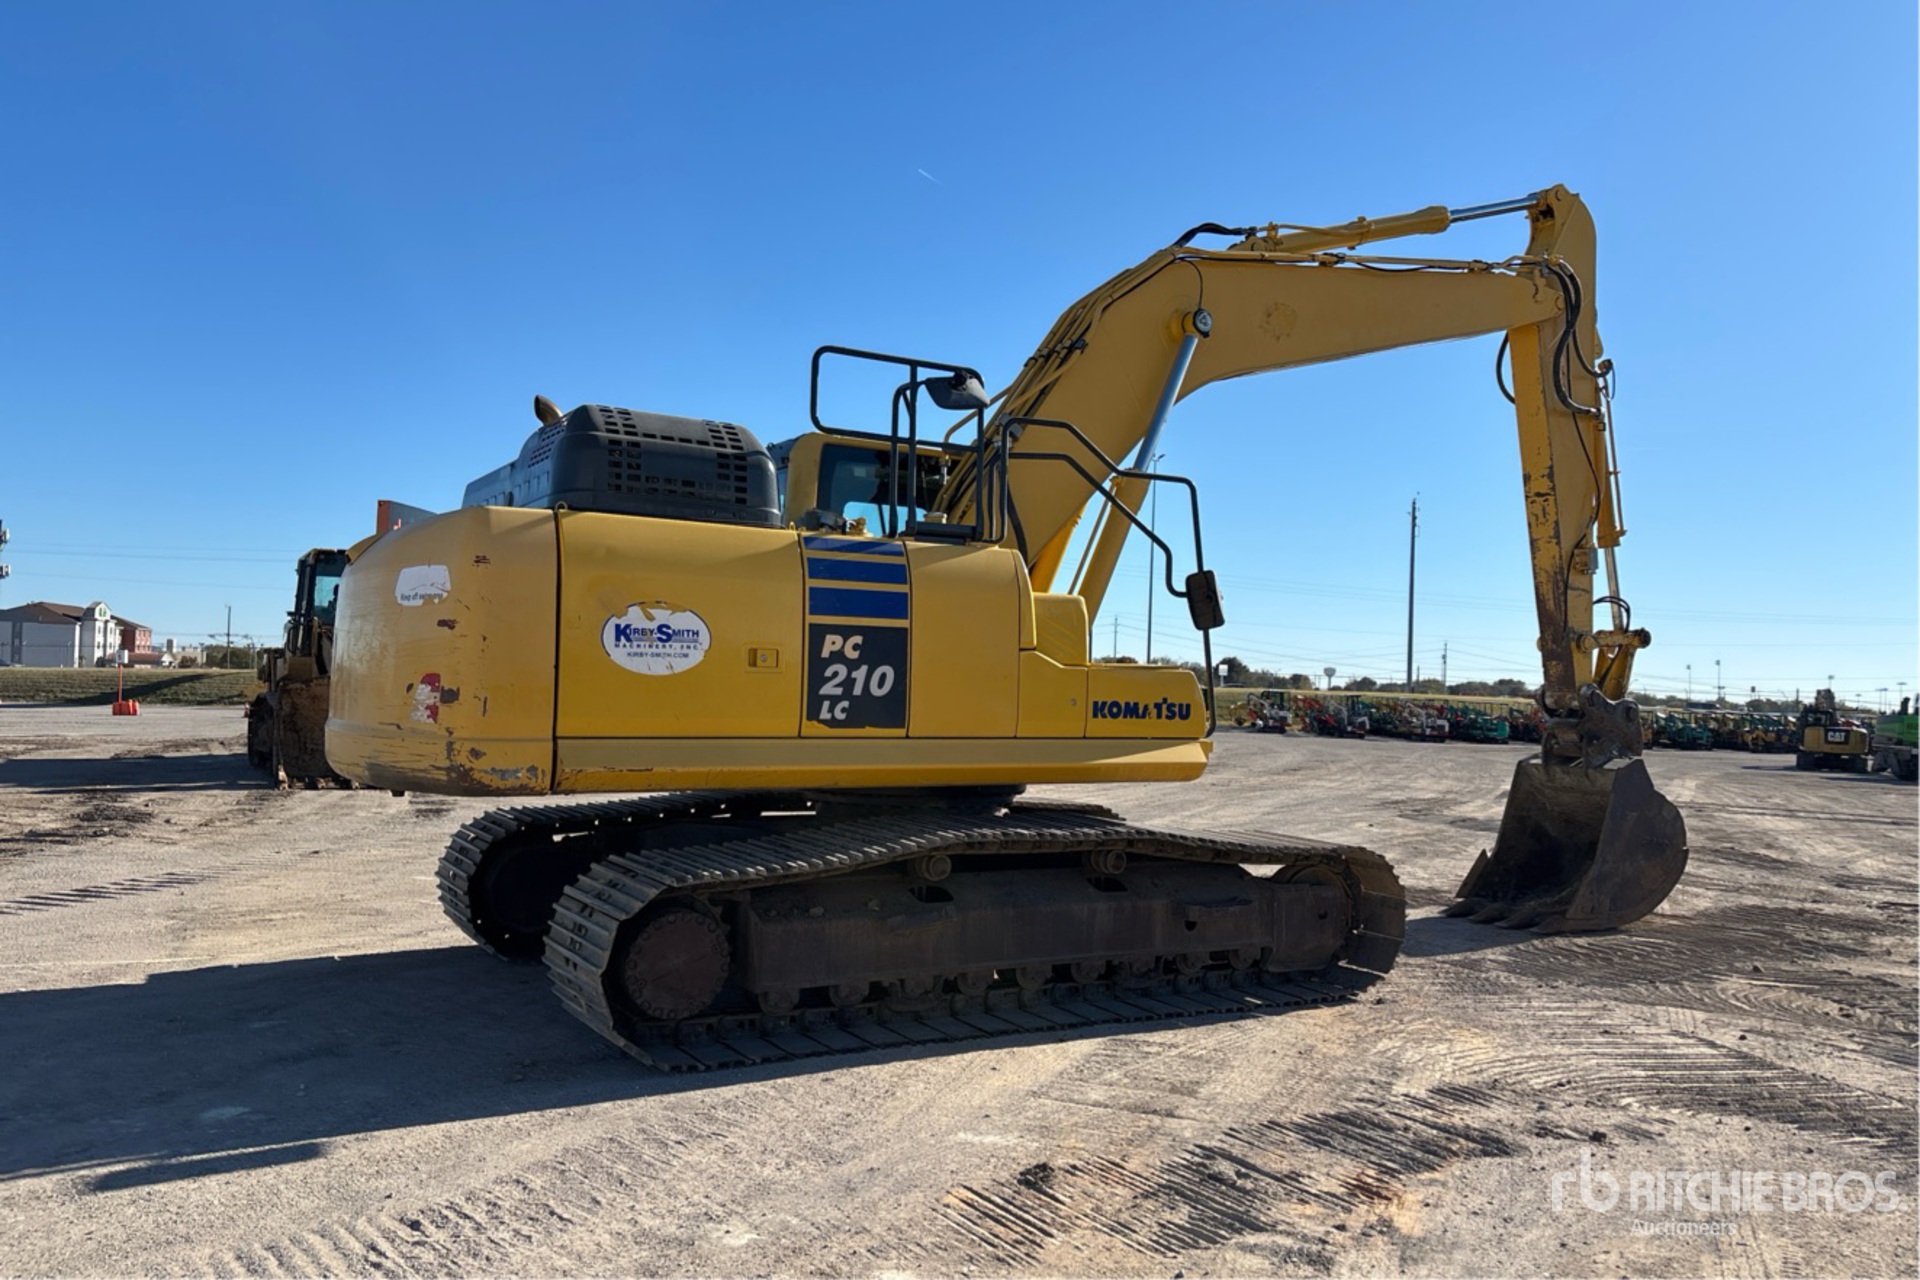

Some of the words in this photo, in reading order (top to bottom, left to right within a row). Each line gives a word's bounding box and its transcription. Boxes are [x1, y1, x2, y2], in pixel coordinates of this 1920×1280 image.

[614, 623, 700, 643] KIRBY-SMITH
[820, 634, 864, 660] PC
[818, 663, 895, 698] 210
[818, 700, 850, 721] LC
[1827, 731, 1846, 742] CAT
